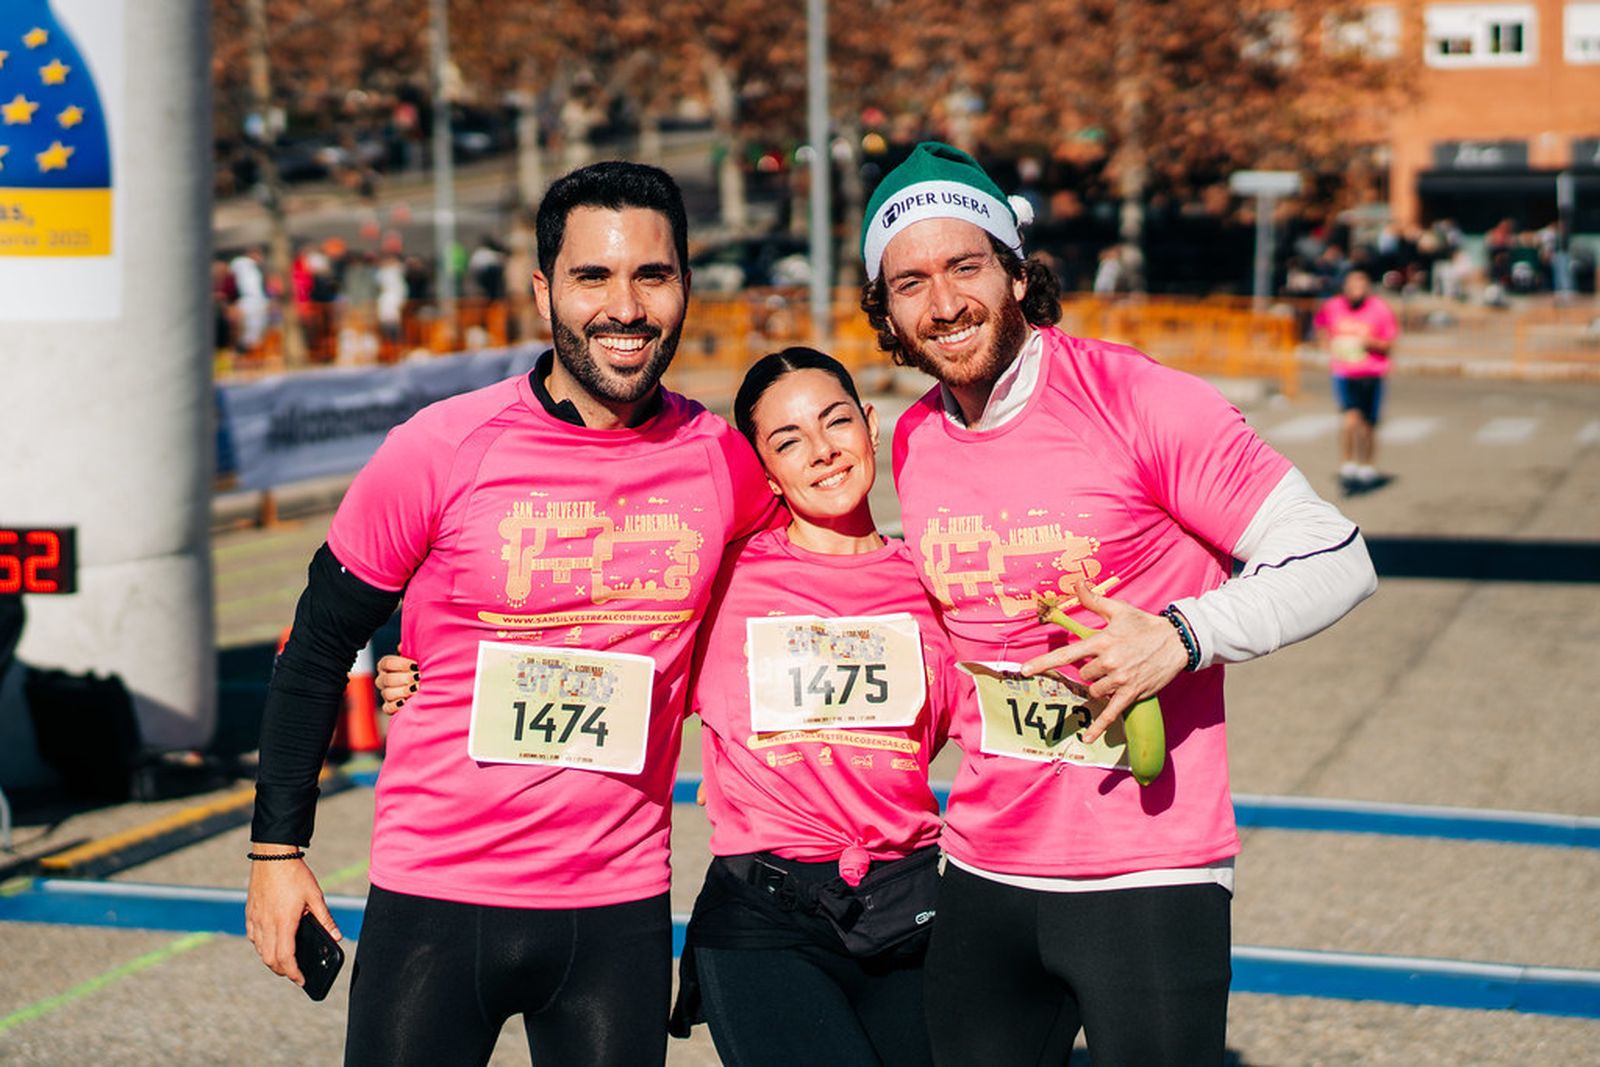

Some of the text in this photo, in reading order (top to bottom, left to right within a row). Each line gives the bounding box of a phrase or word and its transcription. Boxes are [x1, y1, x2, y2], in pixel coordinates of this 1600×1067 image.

[941, 192, 990, 218] USERA
[513, 501, 596, 519] SAN SILVESTRE
[624, 514, 680, 533] ALCOBENDAS
[1008, 523, 1063, 546] ALCOBENDAS
[502, 613, 682, 626] WWW.SANSILVESTREALCOBENDAS.COM
[788, 664, 888, 707] 1475
[512, 701, 609, 748] 1474
[1006, 698, 1092, 743] 1473
